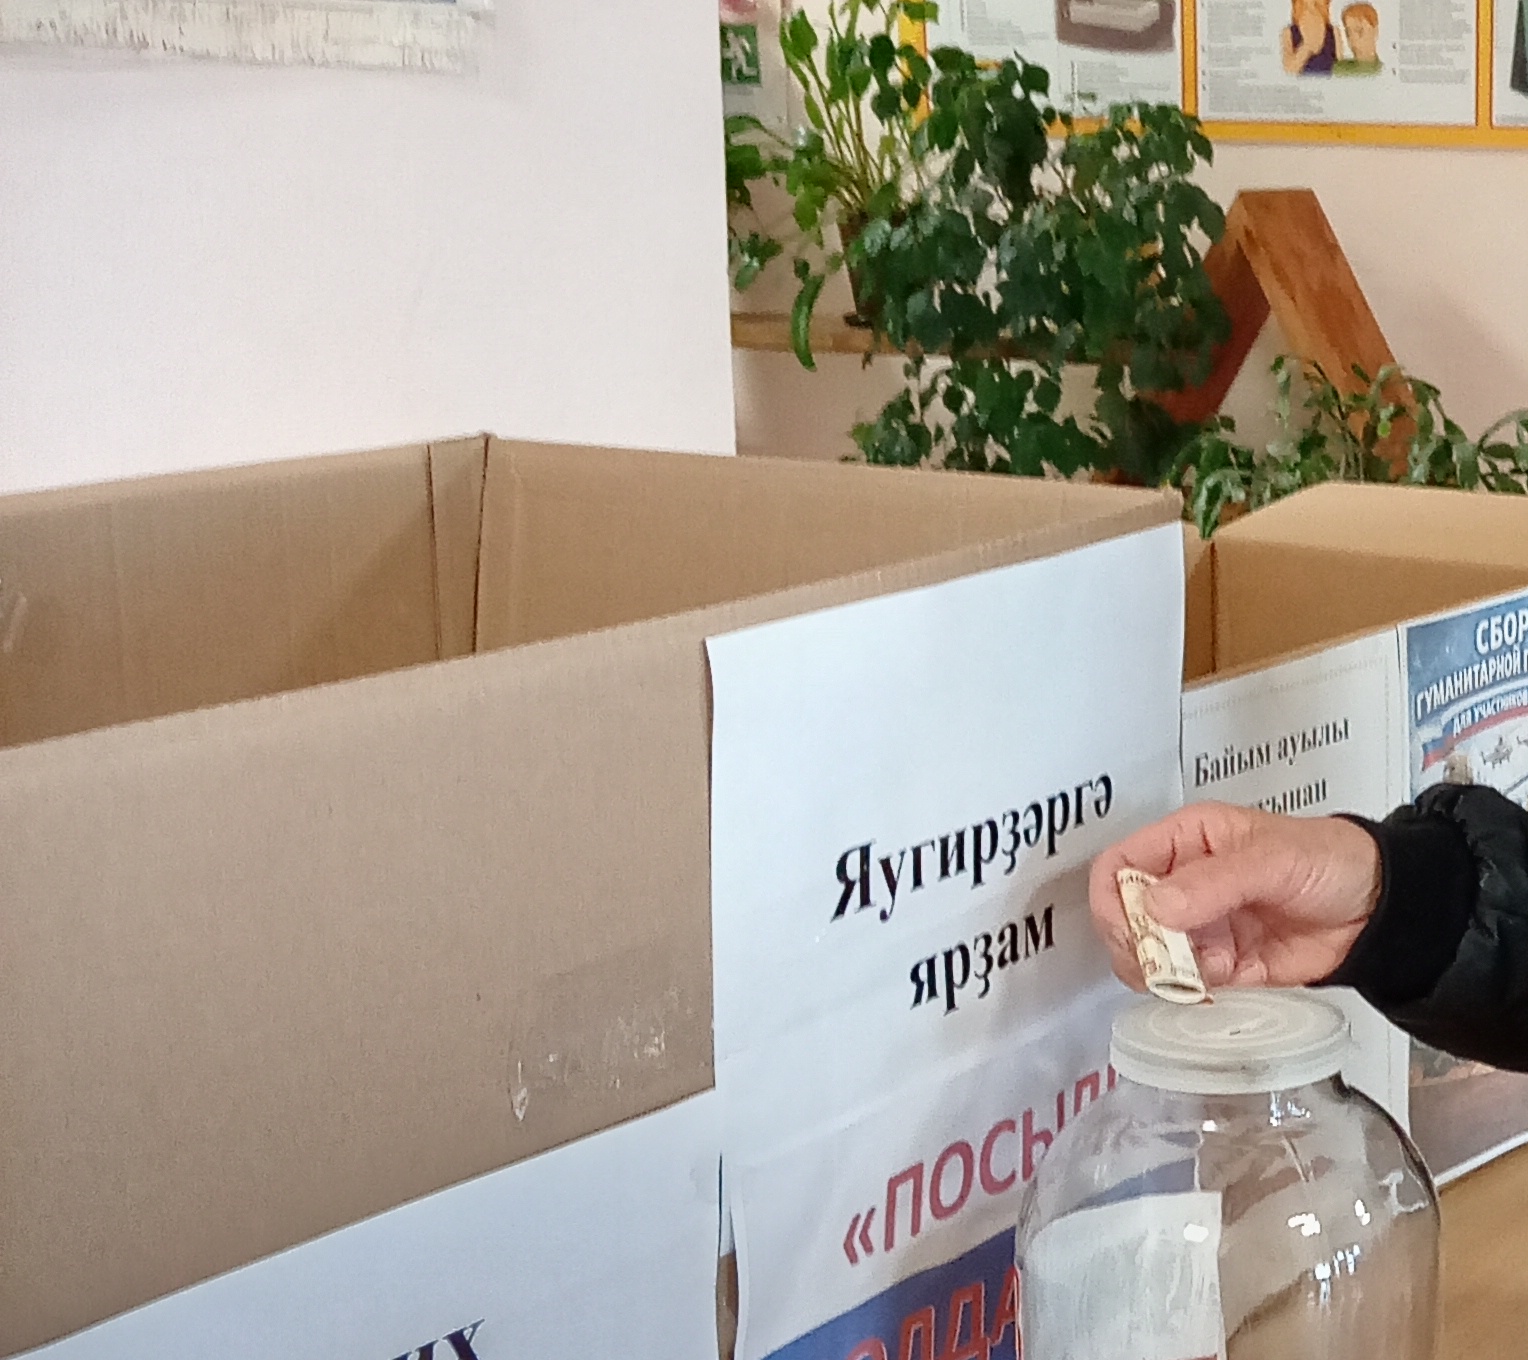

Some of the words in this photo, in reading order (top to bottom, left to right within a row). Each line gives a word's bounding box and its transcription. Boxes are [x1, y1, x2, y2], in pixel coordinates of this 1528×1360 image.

[1415, 646, 1522, 721] ГУМАНИТАРНОЙ
[1452, 710, 1473, 738] ДЛЯ
[1473, 688, 1528, 723] УЧАСТНИКОВ
[1194, 741, 1271, 788] Байым
[1277, 717, 1351, 766] ауылы
[908, 903, 1057, 1016] ярҙам
[840, 1062, 1117, 1267] «ПОСЫЛ
